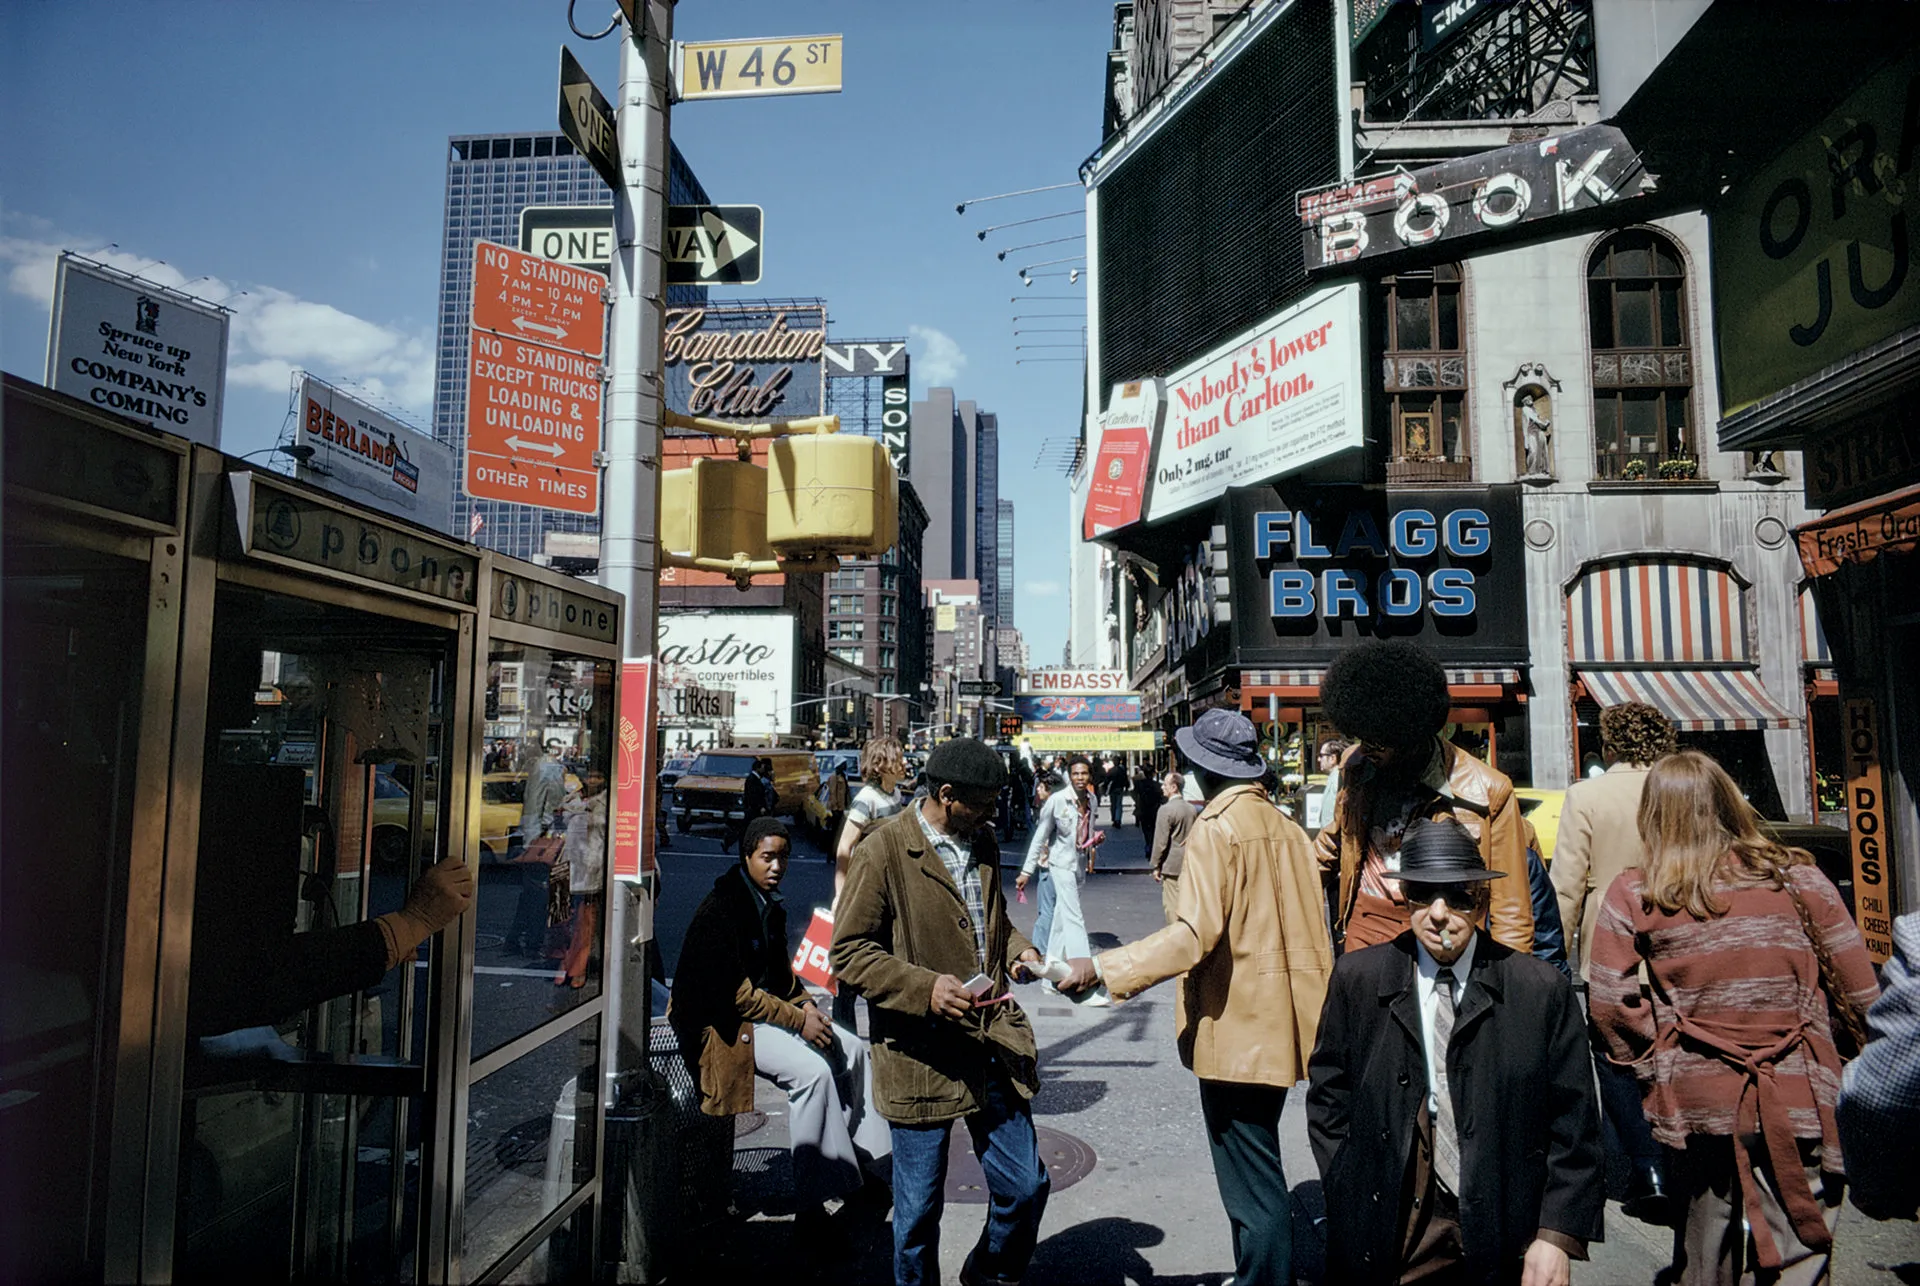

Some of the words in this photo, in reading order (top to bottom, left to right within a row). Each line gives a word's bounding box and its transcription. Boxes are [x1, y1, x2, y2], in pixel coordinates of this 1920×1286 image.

[697, 49, 727, 90] W
[738, 46, 797, 87] 46
[806, 43, 831, 64] ST
[578, 95, 611, 157] ONE
[543, 231, 610, 260] ONE
[485, 248, 509, 270] NO
[520, 259, 598, 294] STANDING
[501, 273, 509, 286] 7
[512, 280, 531, 291] AM
[548, 287, 561, 300] 10
[564, 293, 583, 305] AM
[499, 290, 507, 303] 4
[513, 295, 531, 307] PM
[551, 302, 558, 315] 7
[563, 308, 581, 320] PM
[98, 321, 164, 353] Spruce
[167, 344, 191, 362] up
[664, 307, 825, 362] Canadian
[102, 340, 143, 364] New
[147, 353, 185, 377] York
[480, 337, 502, 358] NO
[516, 346, 596, 381] STANDING
[1176, 346, 1266, 419] Nobody's
[1269, 320, 1333, 373] lower
[71, 357, 207, 407] COMPANY'S
[475, 360, 534, 387] EXCEPT
[540, 374, 598, 401] TRUCKS
[687, 362, 793, 416] Club
[90, 387, 189, 425] COMING
[489, 385, 562, 416] LOADING
[570, 403, 582, 420] &
[1177, 414, 1221, 451] than
[1223, 372, 1314, 427] Carlton.
[306, 397, 395, 468] BERLAND
[486, 407, 584, 442] UNLOADING
[476, 467, 529, 488] OTHER
[538, 478, 588, 499] TIMES
[1159, 464, 1184, 485] Only
[1185, 458, 1192, 474] 2
[1194, 455, 1213, 471] mg.
[1214, 446, 1232, 463] tar
[1254, 509, 1491, 559] FLAGG
[1816, 520, 1869, 558] Fresh
[1881, 510, 1920, 541] Ora
[528, 591, 608, 631] phone
[1270, 568, 1476, 617] BROS
[698, 669, 775, 682] convertibles
[1031, 673, 1124, 689] EMBASSY
[1850, 706, 1874, 778] HOT
[1855, 787, 1882, 886] DOGS
[1862, 896, 1882, 914] CHILI
[1863, 916, 1890, 936] CHEESE
[1865, 937, 1890, 956] KRAUT
[792, 937, 833, 975] ga
